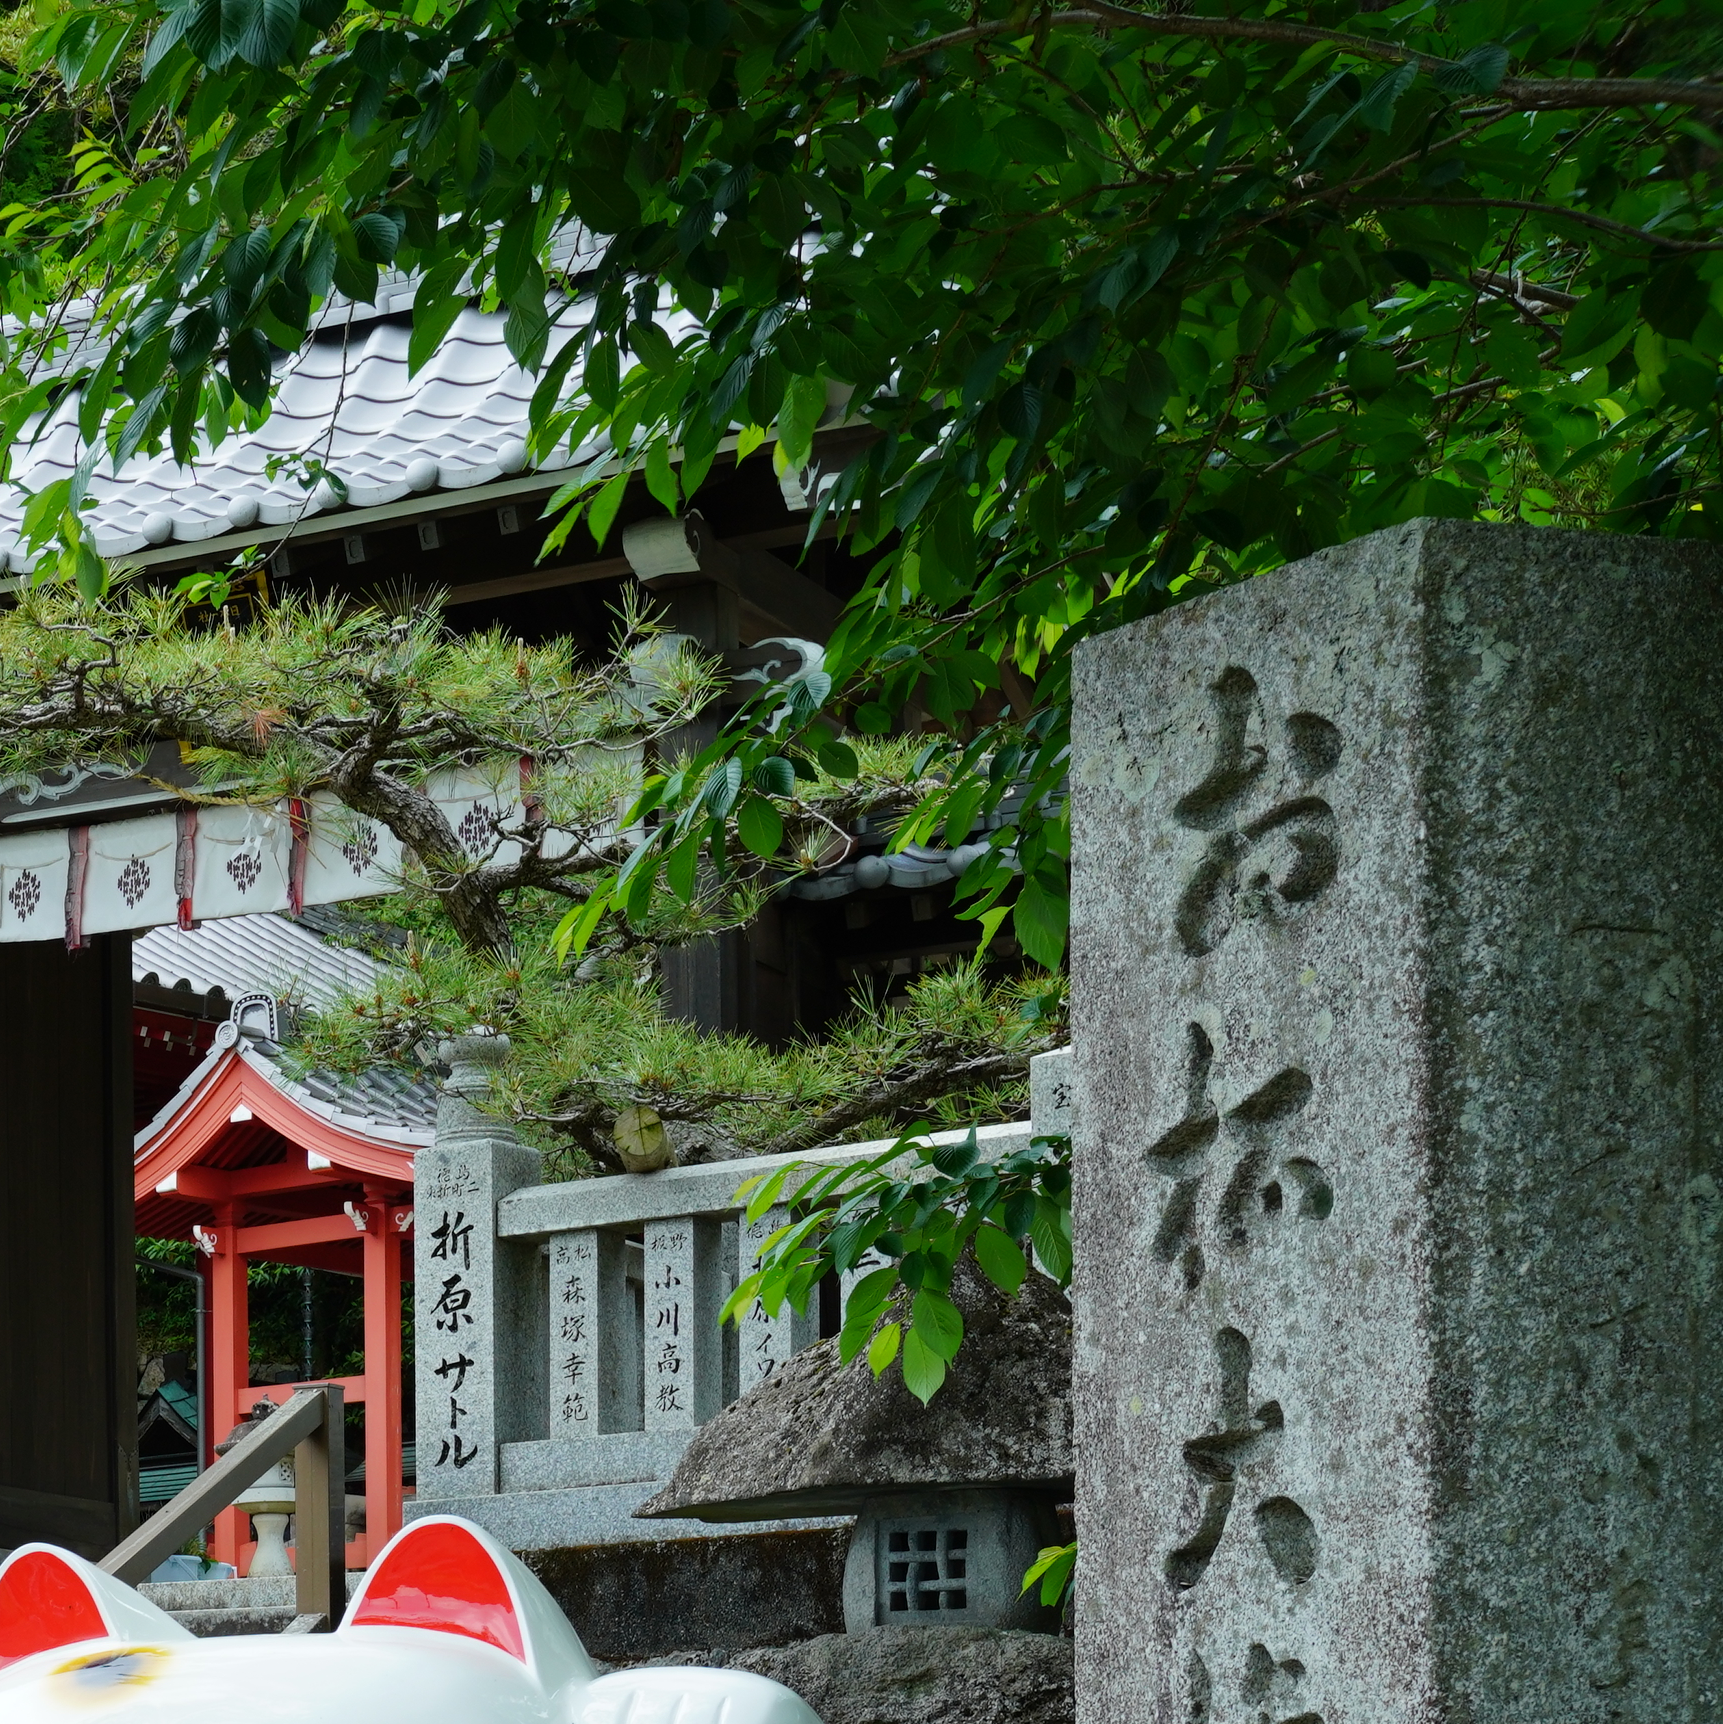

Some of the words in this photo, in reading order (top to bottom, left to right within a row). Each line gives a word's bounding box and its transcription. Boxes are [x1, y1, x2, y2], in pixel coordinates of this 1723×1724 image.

[556, 1244, 592, 1265] 高松
[430, 1210, 479, 1470] 折原サトル
